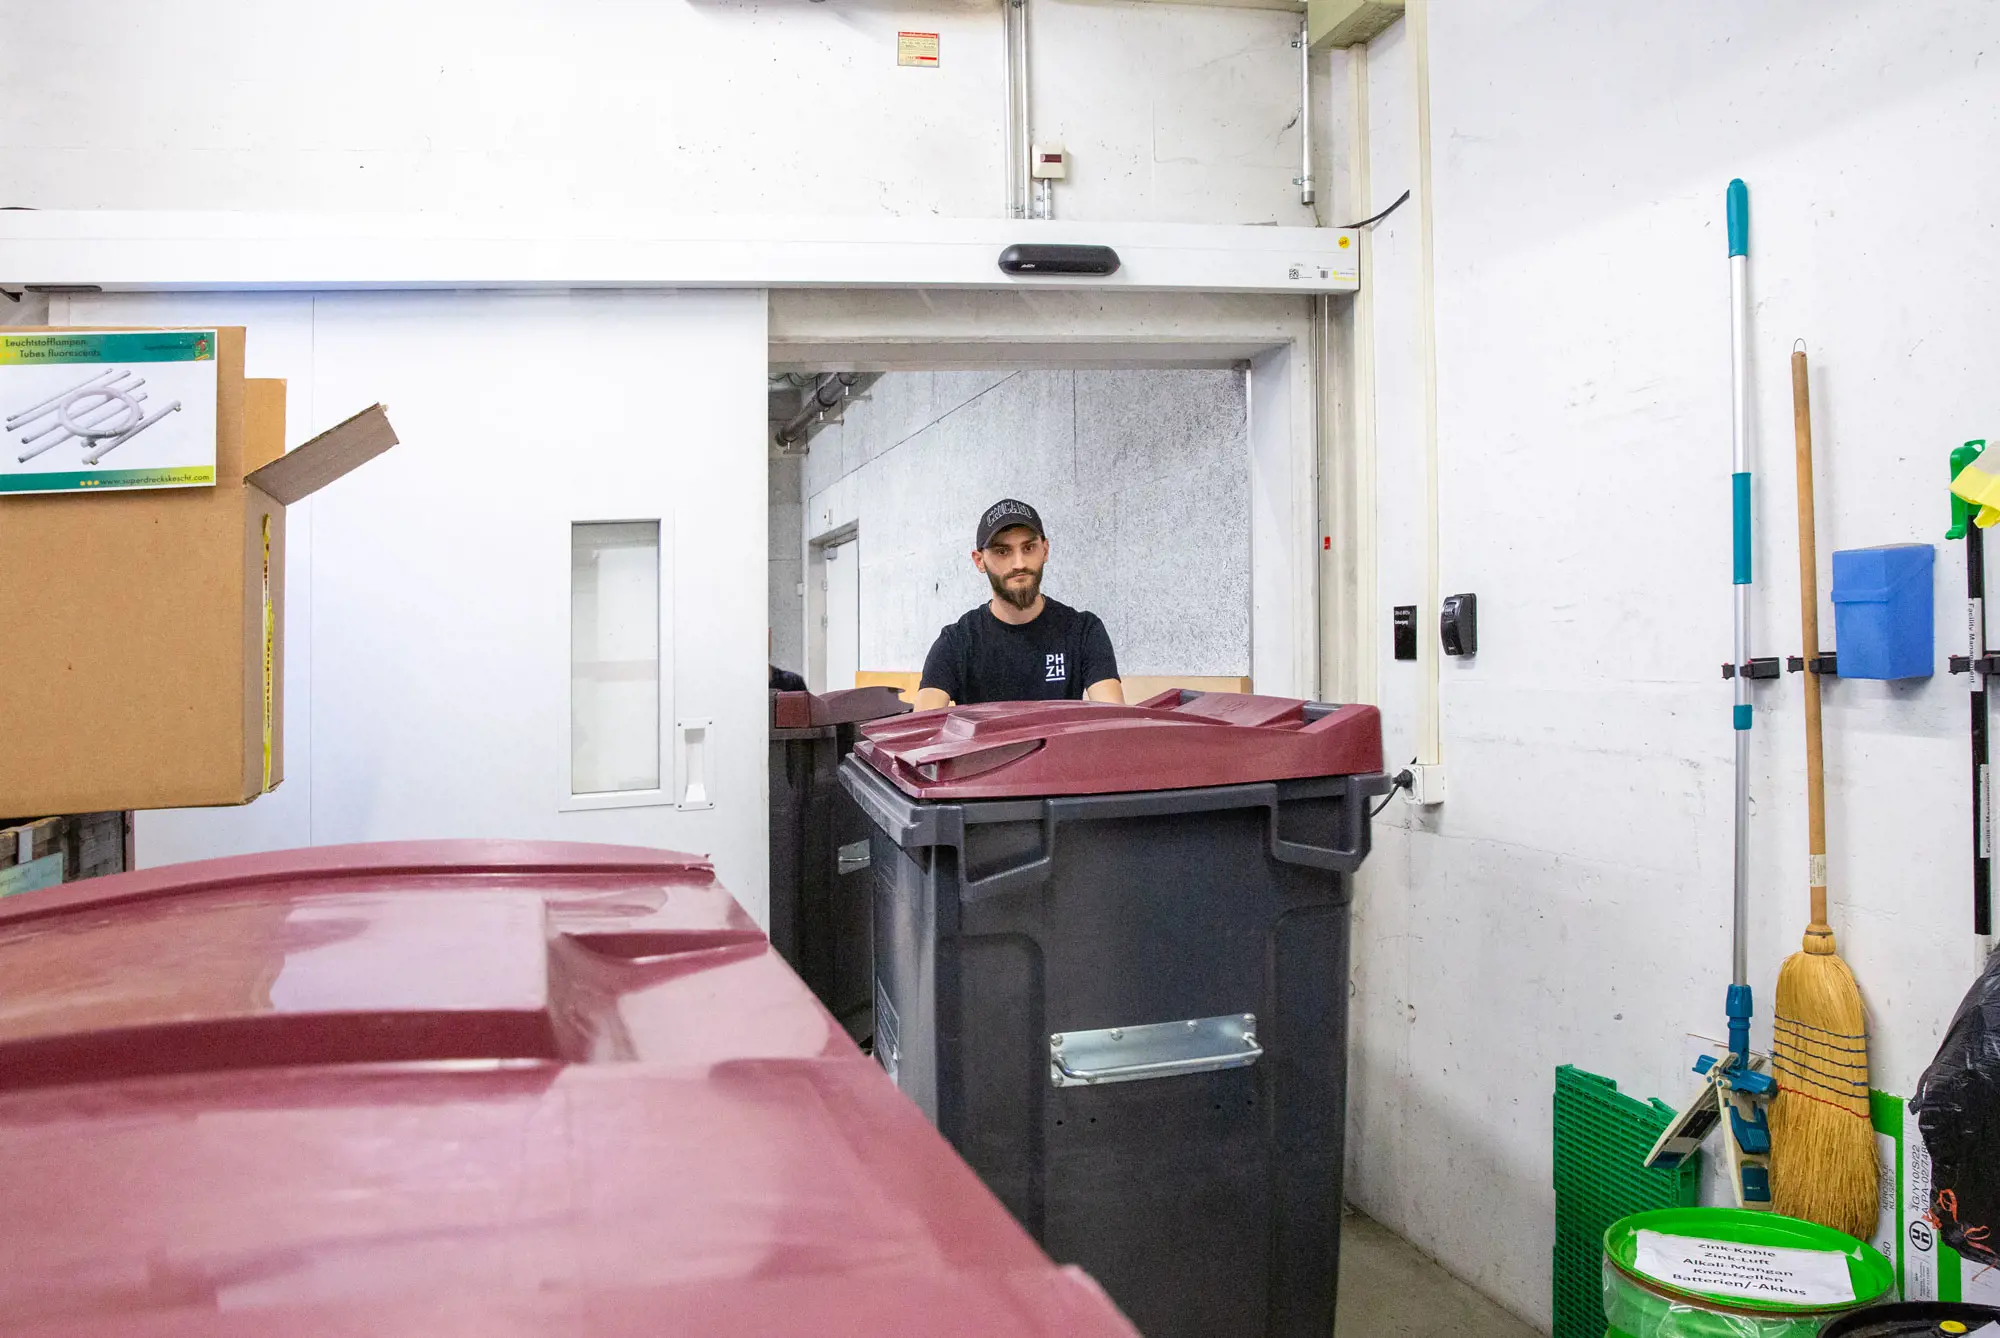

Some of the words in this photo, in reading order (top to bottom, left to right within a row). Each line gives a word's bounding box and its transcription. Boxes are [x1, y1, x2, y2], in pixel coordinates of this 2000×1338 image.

[5, 337, 87, 348] Leuchtstofflampen
[19, 349, 46, 358] Tubes
[48, 348, 102, 358] fluorescents
[1045, 652, 1065, 666] PH
[1045, 664, 1066, 678] ZH
[1911, 1144, 1920, 1212] 4G/Y10/S/22
[1697, 1243, 1777, 1258] Zink-Kohle
[1704, 1251, 1771, 1266] Zink-Luft
[1682, 1258, 1794, 1278] Alkali-Mangan
[1693, 1267, 1784, 1284] Knopfzellen
[1672, 1273, 1807, 1296] Batterien/-Akkus
